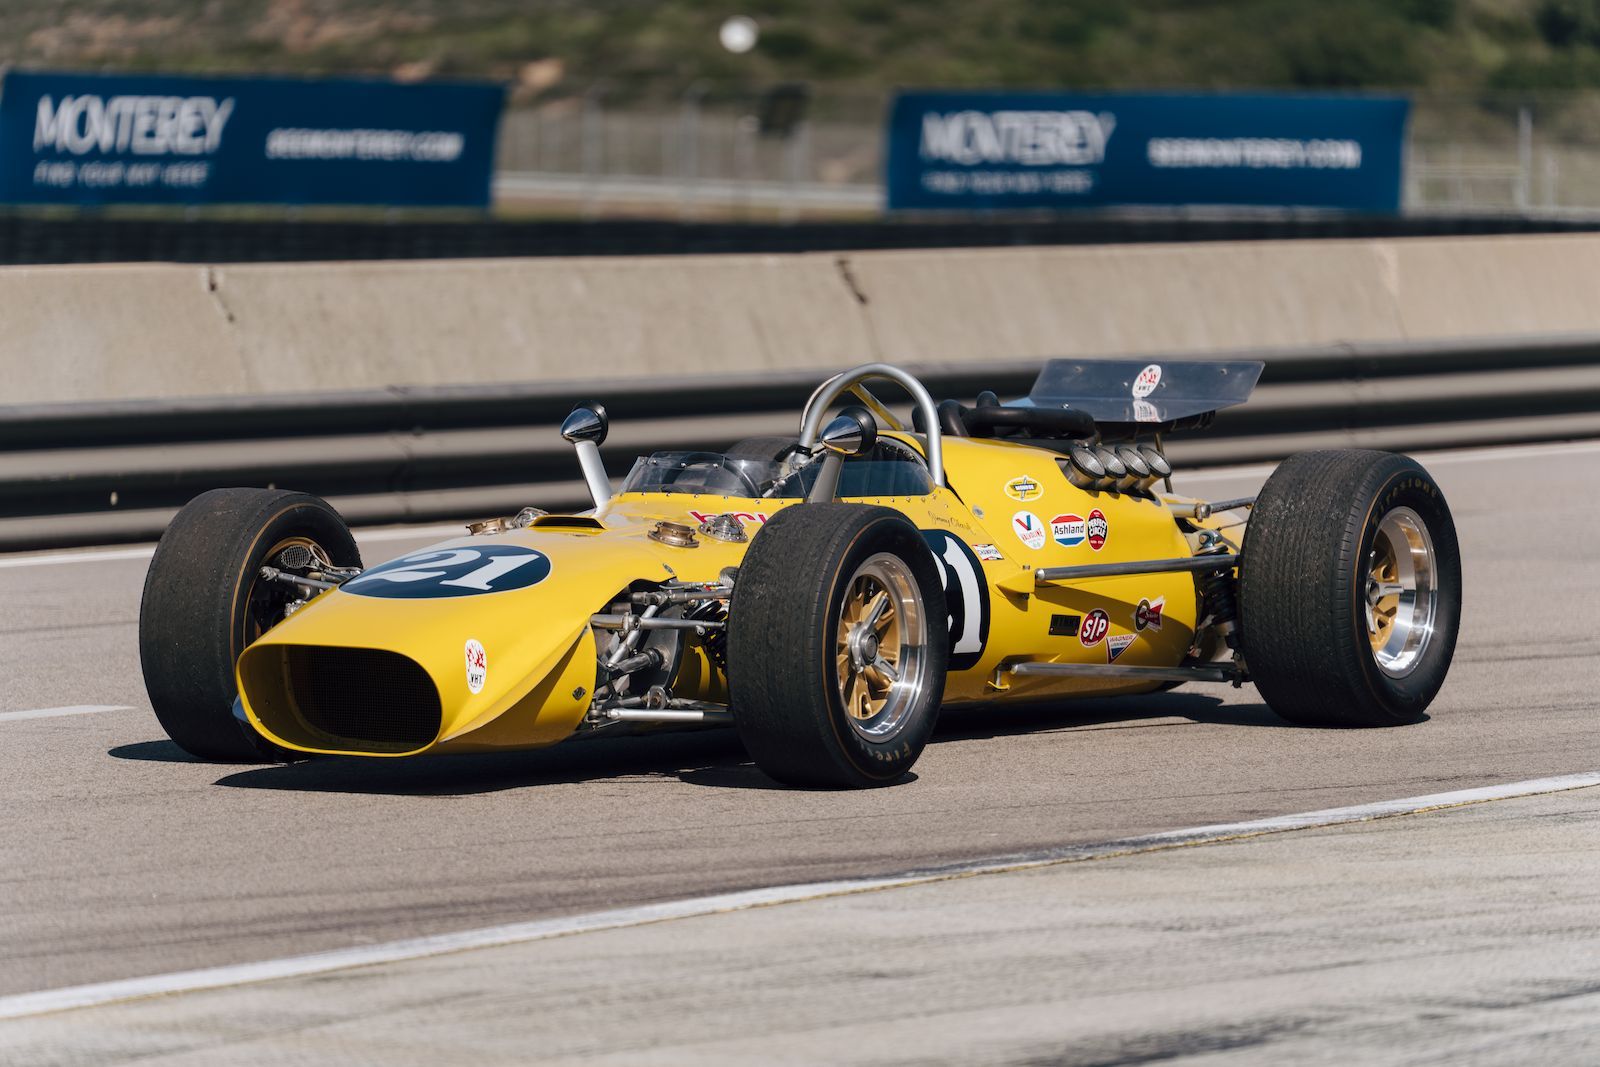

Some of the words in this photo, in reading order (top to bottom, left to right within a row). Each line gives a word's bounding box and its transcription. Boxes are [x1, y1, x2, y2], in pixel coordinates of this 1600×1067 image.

[33, 95, 236, 155] MONTEREY
[919, 111, 1116, 165] MONTEREY
[1054, 523, 1084, 535] Ashland
[344, 548, 540, 591] 21
[931, 535, 982, 654] 1
[1083, 612, 1107, 641] STP
[470, 673, 483, 685] VHT
